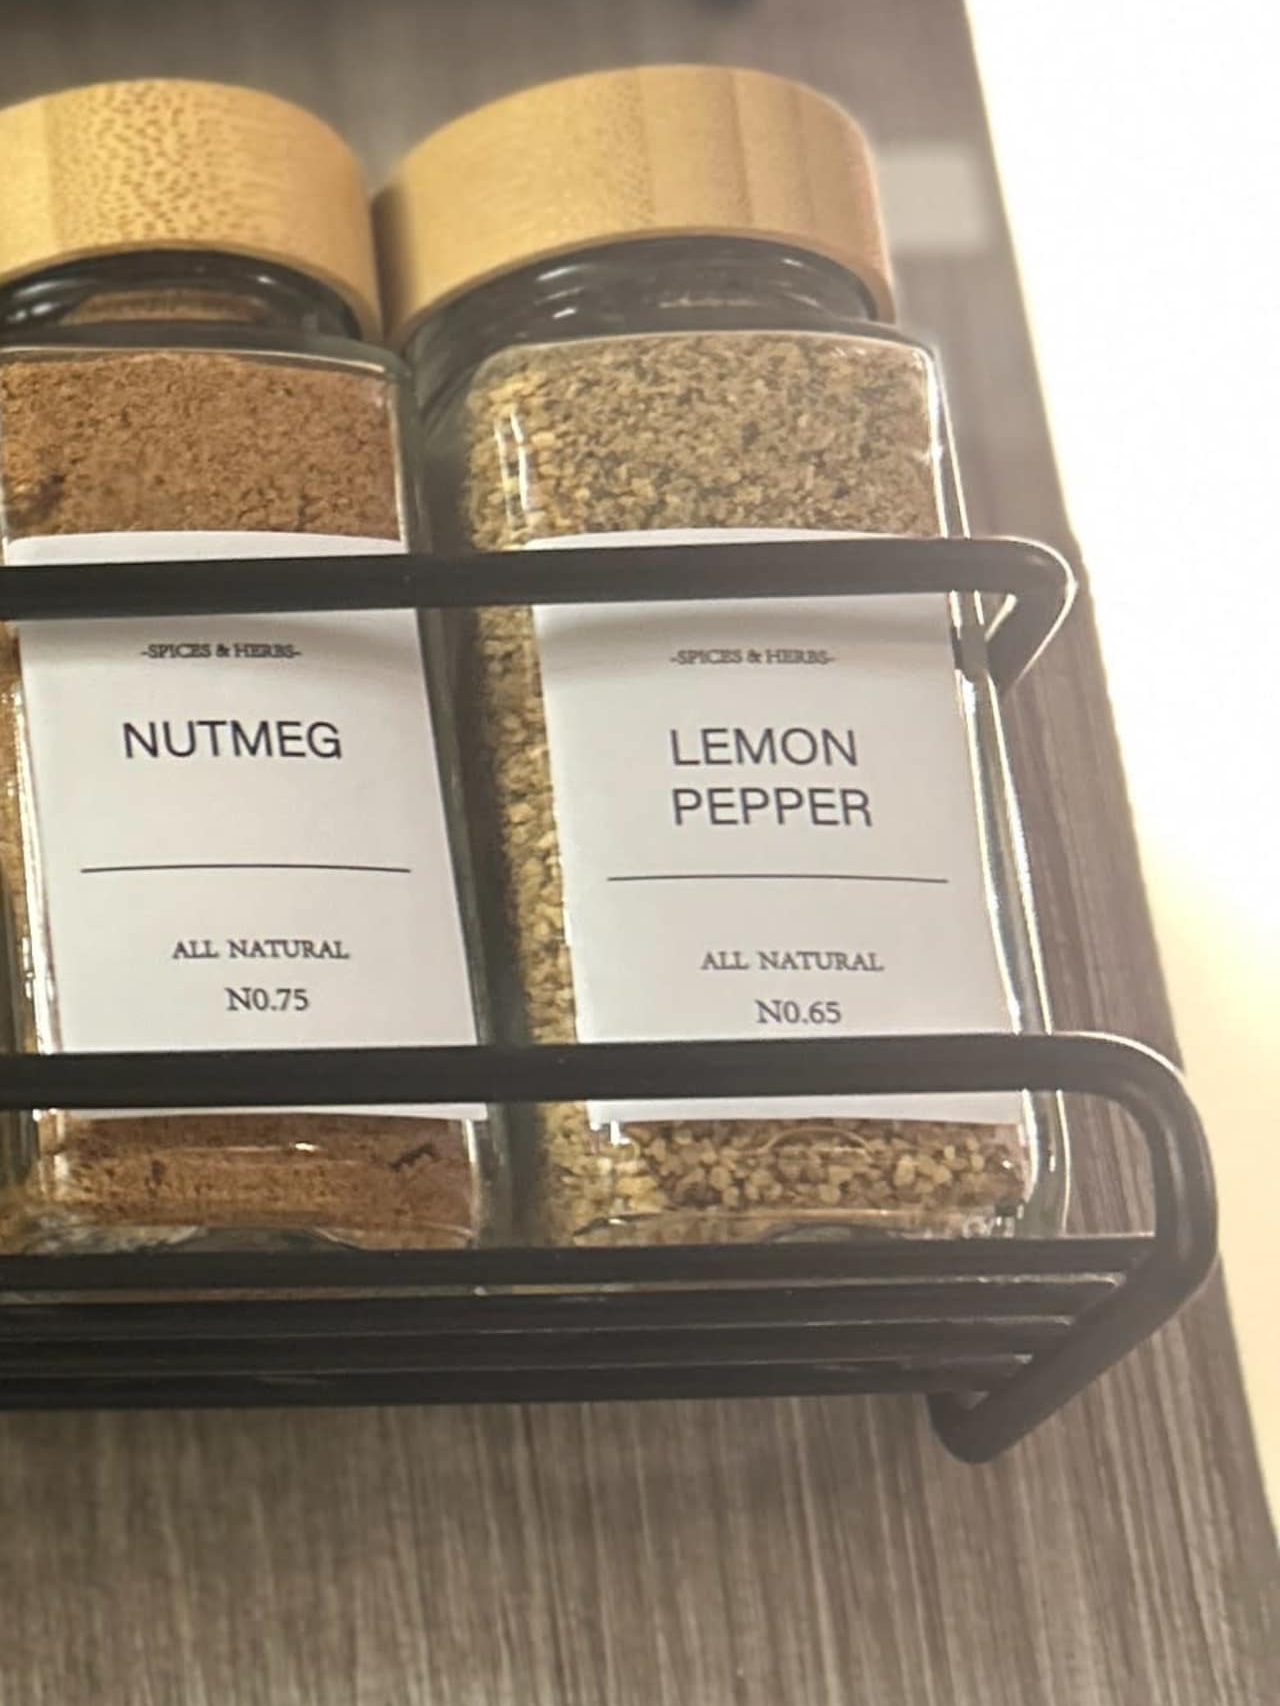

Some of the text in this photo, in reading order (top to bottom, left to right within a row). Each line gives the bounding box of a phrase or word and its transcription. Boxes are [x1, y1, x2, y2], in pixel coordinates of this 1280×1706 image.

[216, 643, 230, 658] &
[747, 649, 762, 663] &
[123, 720, 341, 758] NUTMEG
[671, 728, 857, 766] LEMON
[672, 787, 872, 826] PEPPER
[172, 939, 350, 959] ALL NATURAL
[701, 951, 885, 972] ALL NATURAL
